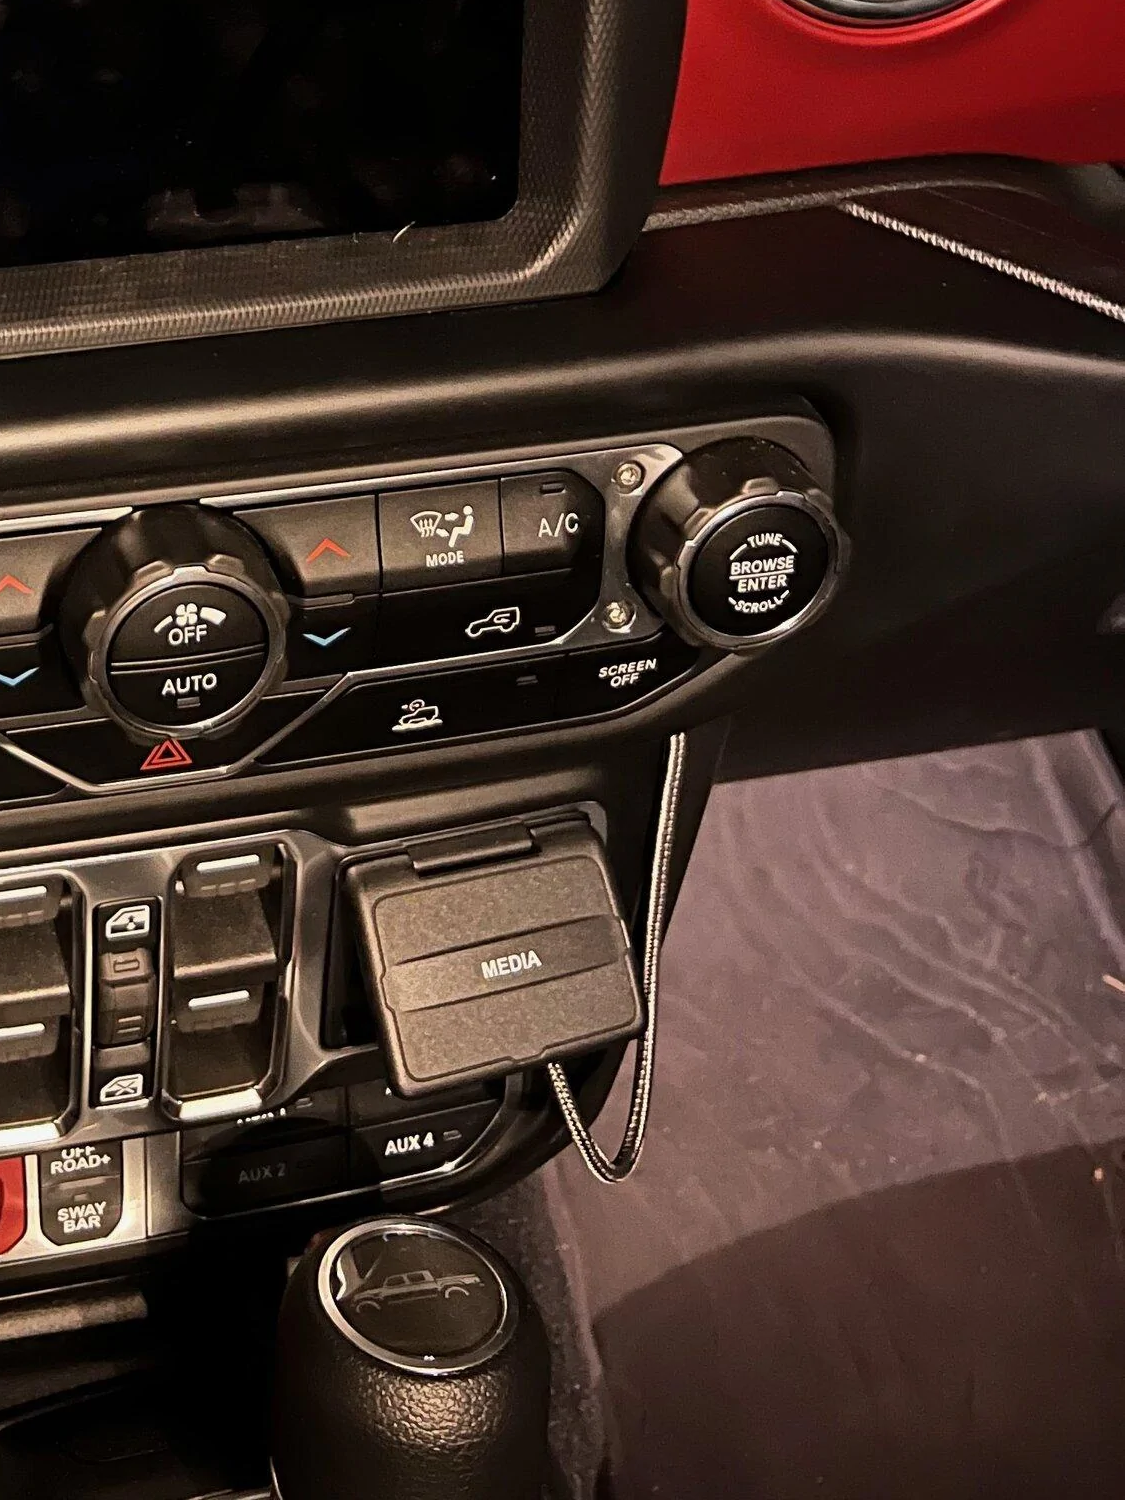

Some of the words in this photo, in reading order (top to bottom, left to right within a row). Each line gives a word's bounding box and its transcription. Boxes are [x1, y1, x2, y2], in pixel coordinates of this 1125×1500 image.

[537, 512, 579, 539] A/C
[747, 532, 783, 548] TUNE
[426, 549, 465, 567] MODE
[730, 555, 795, 576] BROWSE
[737, 574, 788, 594] ENTER
[734, 596, 784, 614] SCROLL
[168, 624, 209, 646] OFF
[598, 657, 657, 680] SCREEN
[610, 670, 640, 688] OFF
[161, 670, 218, 697] AUTO
[480, 950, 543, 979] MEDIA
[384, 1134, 421, 1156] AUX
[422, 1131, 435, 1148] 4
[50, 1154, 112, 1175] ROAD+
[237, 1164, 273, 1185] AUX
[277, 1162, 287, 1178] 2
[57, 1201, 107, 1222] SWAY
[63, 1215, 102, 1234] BAR
